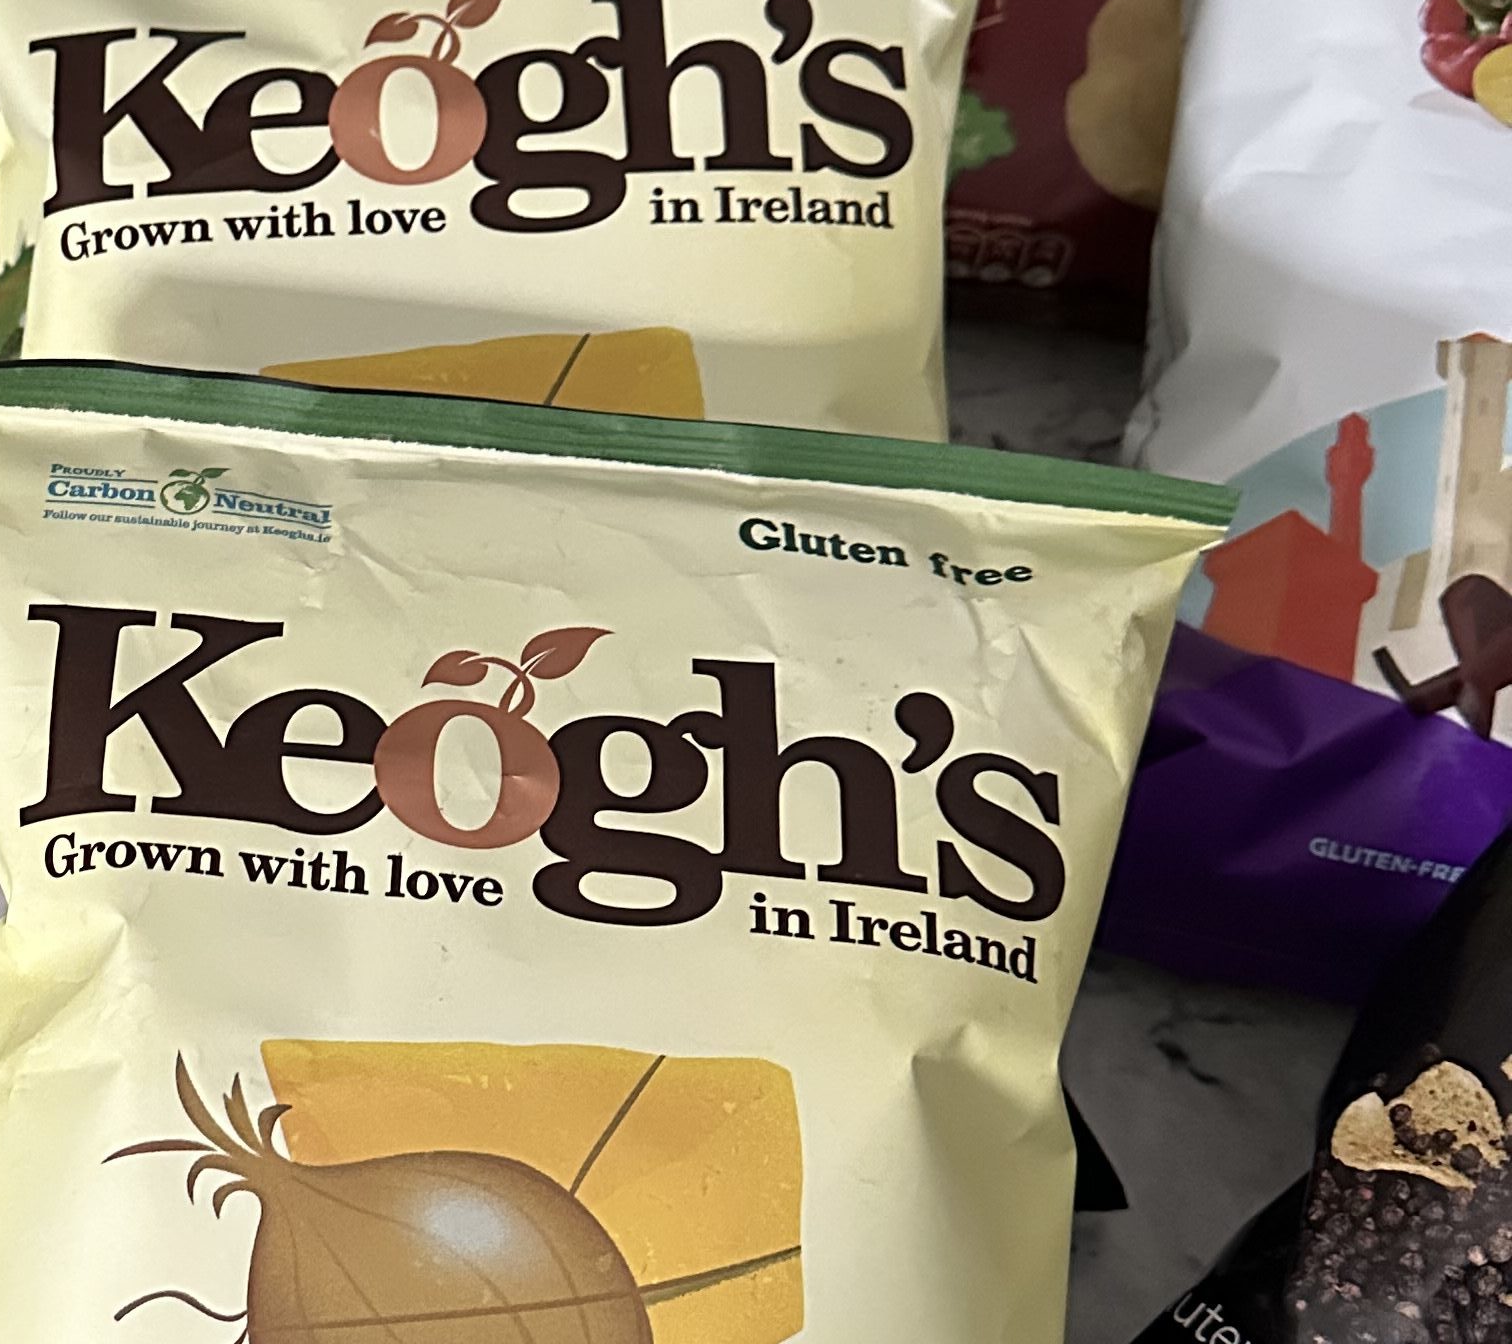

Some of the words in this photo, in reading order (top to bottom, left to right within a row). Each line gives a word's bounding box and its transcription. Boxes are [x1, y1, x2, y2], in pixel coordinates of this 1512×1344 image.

[59, 212, 213, 262] Grown
[222, 201, 333, 242] with
[347, 198, 447, 236] love
[649, 187, 704, 226] in
[714, 186, 894, 231] Ireland
[50, 463, 127, 478] PROUDLY
[43, 509, 88, 522] Follow
[89, 513, 113, 523] our
[114, 515, 190, 529] sustainable
[191, 519, 245, 535] journey
[47, 479, 156, 502] Carbon
[213, 492, 333, 525] Neutral
[737, 516, 910, 568] Gluten
[928, 553, 1034, 586] free
[18, 603, 1067, 927] Keogh's
[44, 831, 225, 879] Grown
[237, 848, 370, 896] with
[385, 853, 505, 907] love
[1308, 836, 1469, 884] GLUTEN-FRE
[749, 891, 816, 941] in
[828, 899, 1039, 985] Ireland
